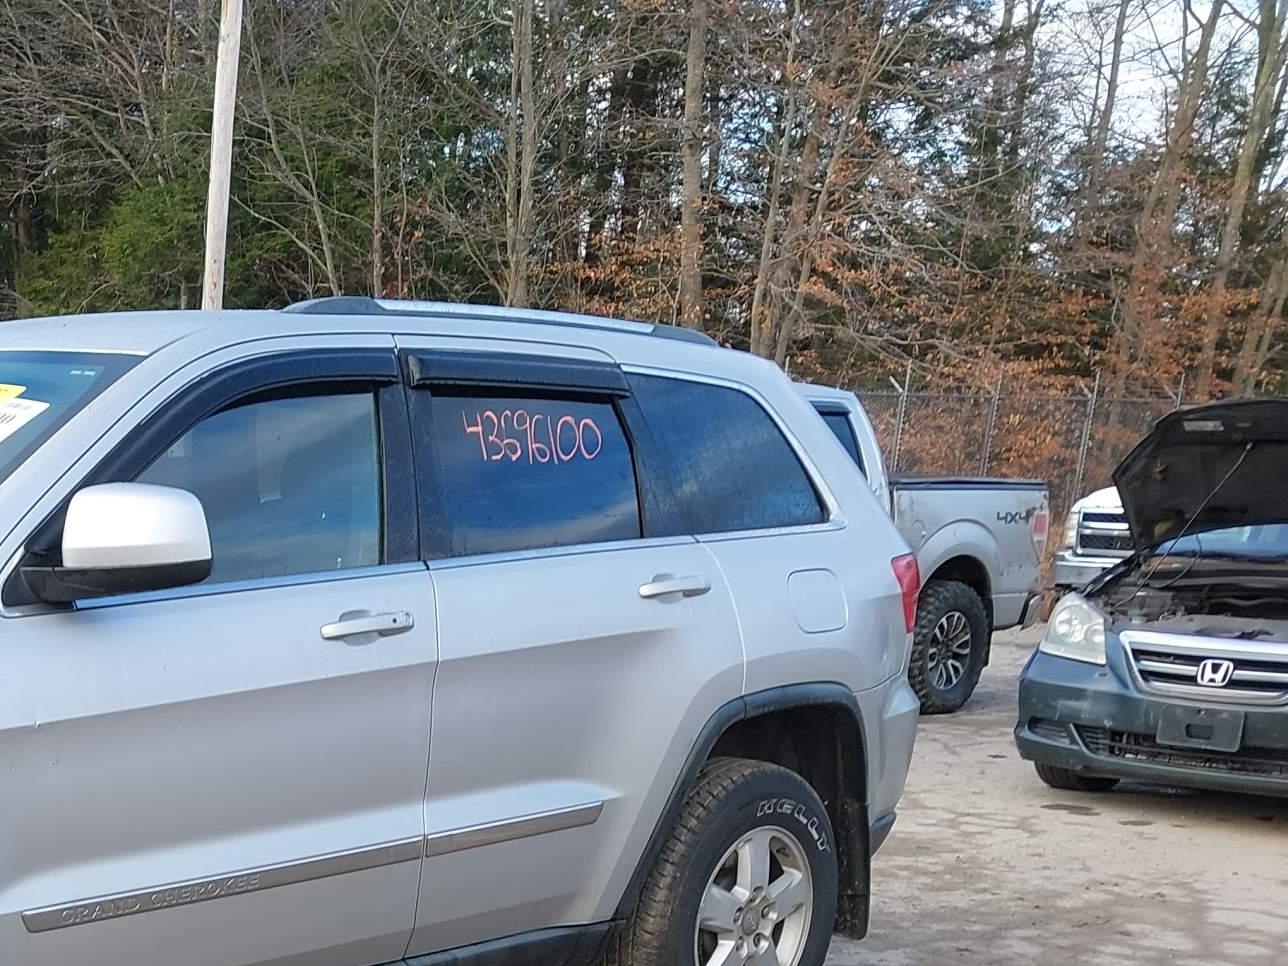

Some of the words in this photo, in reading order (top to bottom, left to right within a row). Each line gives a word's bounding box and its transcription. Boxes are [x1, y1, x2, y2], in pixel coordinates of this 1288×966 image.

[756, 798, 831, 854] KELLY
[61, 896, 141, 924] GRAND
[151, 873, 262, 907] CHEROKEE
